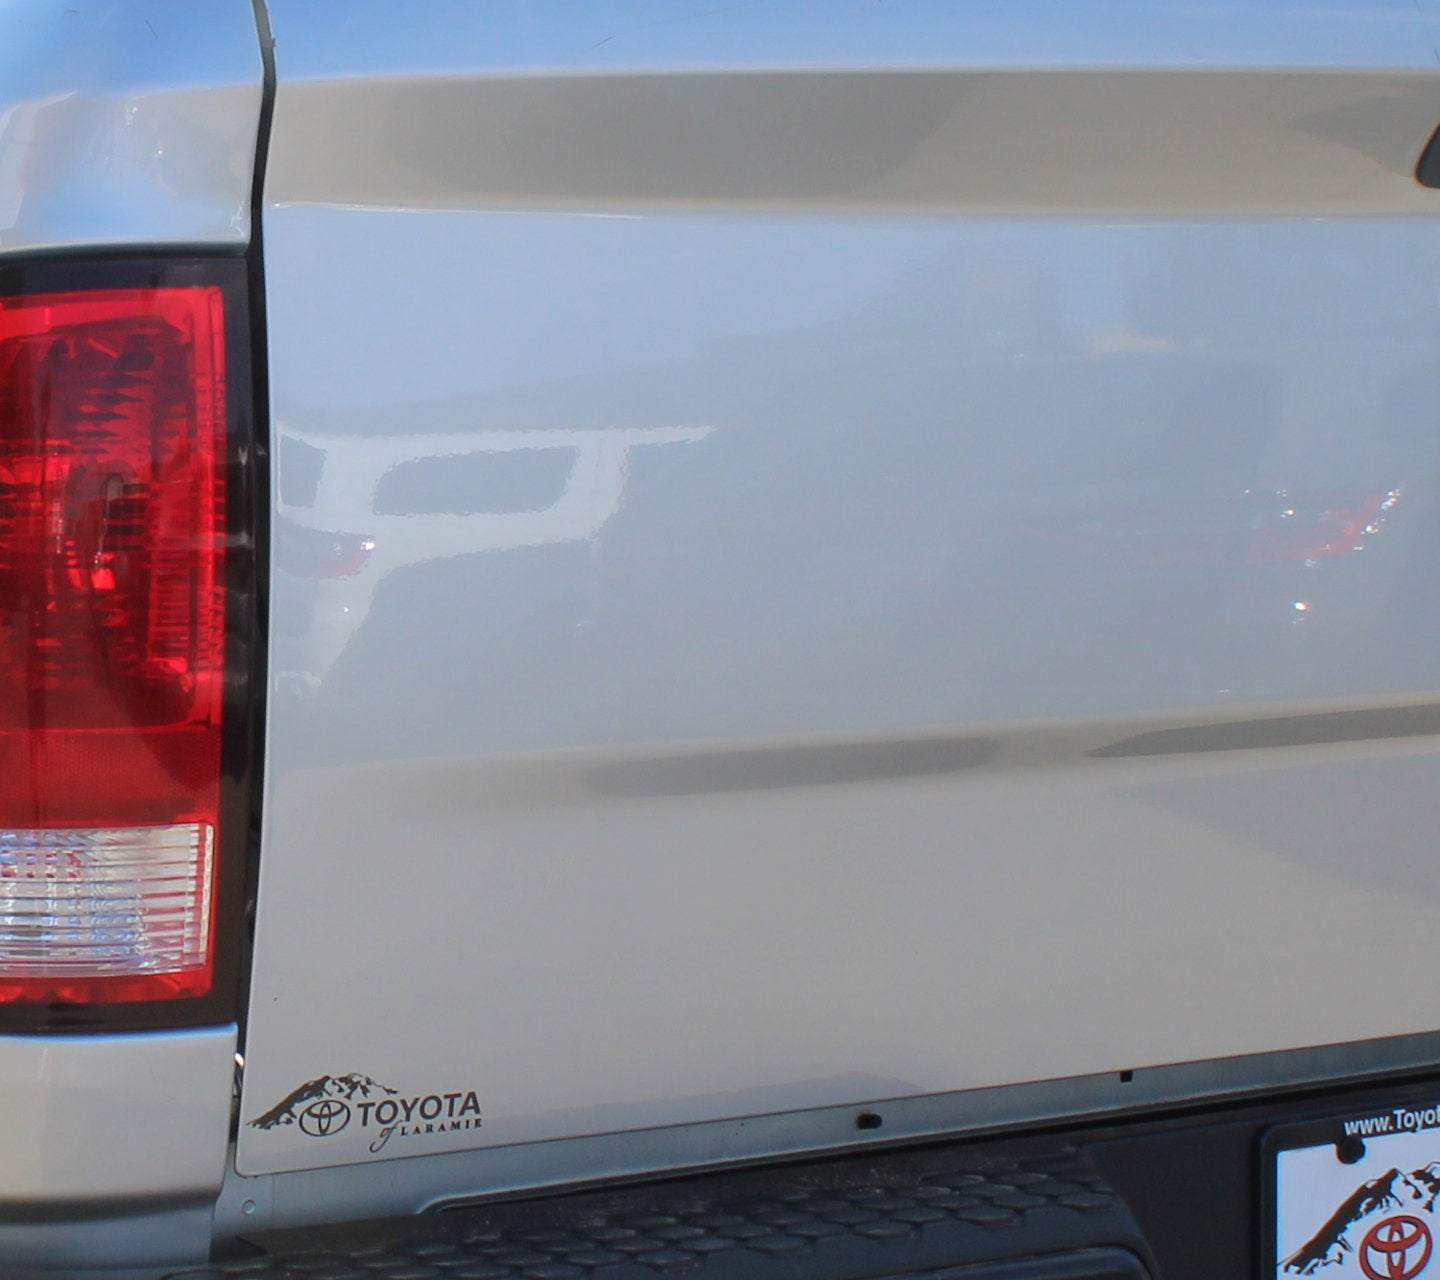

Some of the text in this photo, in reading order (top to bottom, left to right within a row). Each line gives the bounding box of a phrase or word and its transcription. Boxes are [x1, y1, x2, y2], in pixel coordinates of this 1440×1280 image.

[357, 1091, 481, 1127] TOYOTA
[369, 1118, 482, 1153] of LARAMIE
